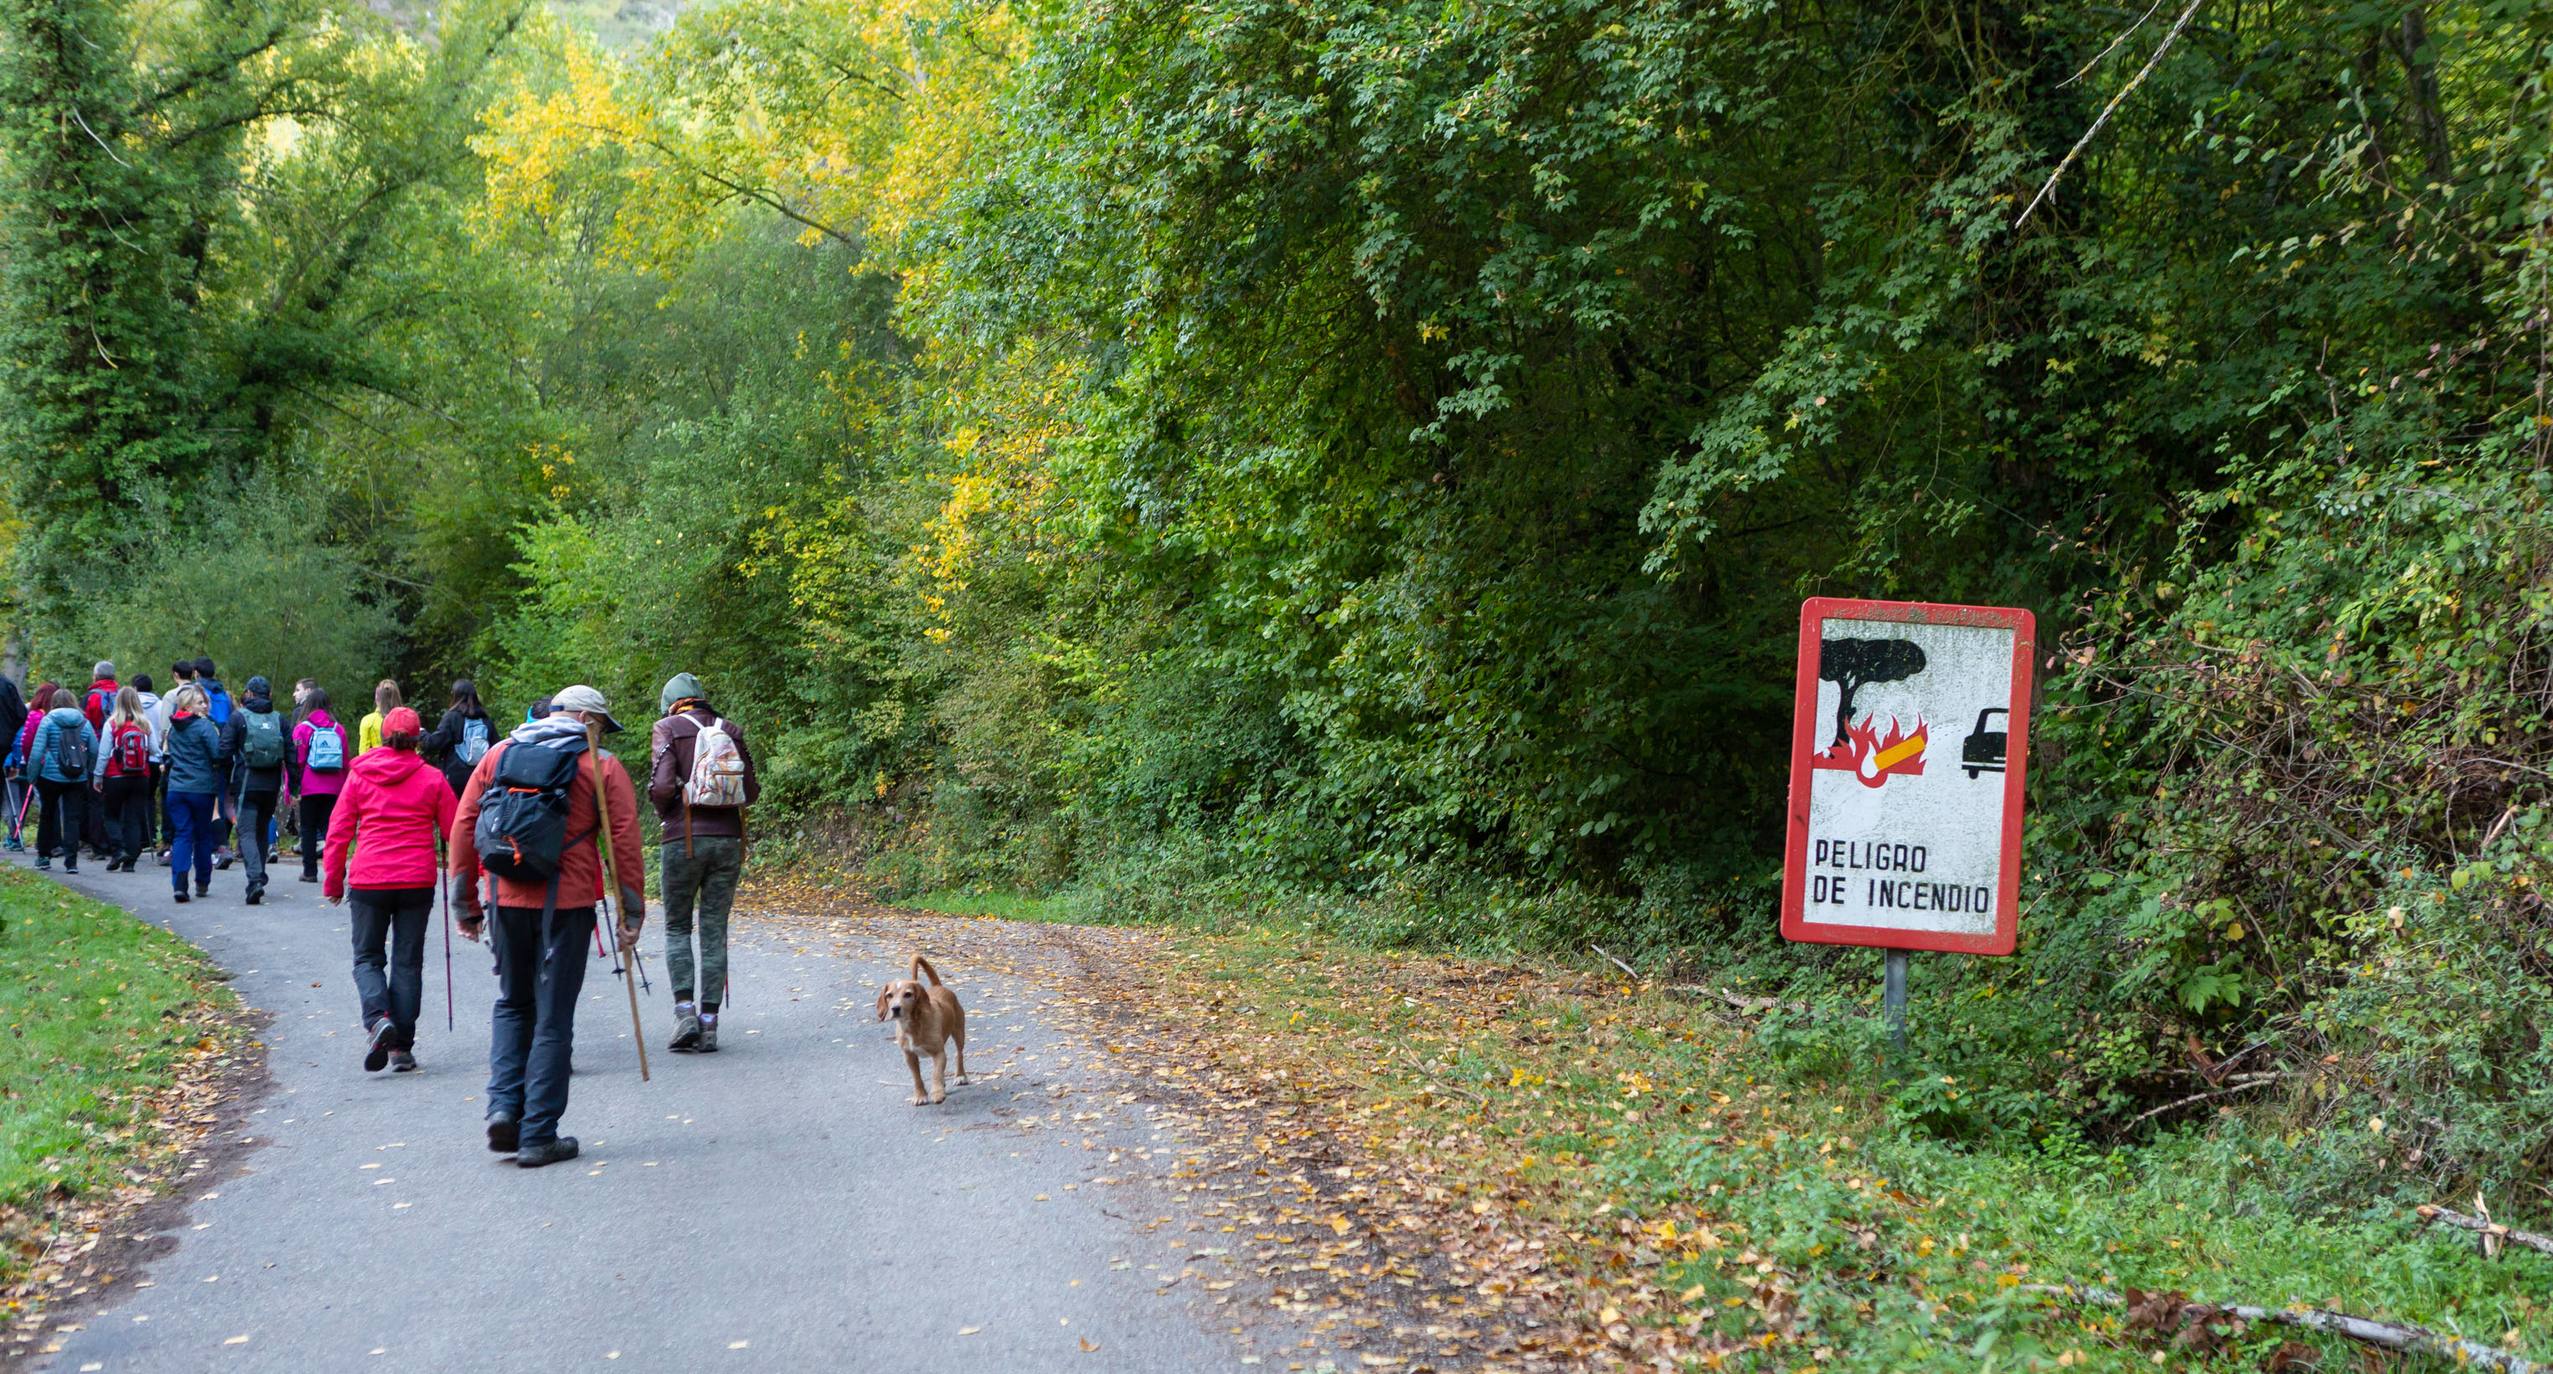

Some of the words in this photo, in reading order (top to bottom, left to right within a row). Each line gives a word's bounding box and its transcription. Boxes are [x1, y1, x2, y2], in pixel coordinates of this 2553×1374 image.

[1815, 839, 1927, 873] PELIGRO
[1813, 875, 1846, 905] DE
[1868, 878, 1989, 914] INCENDIO
